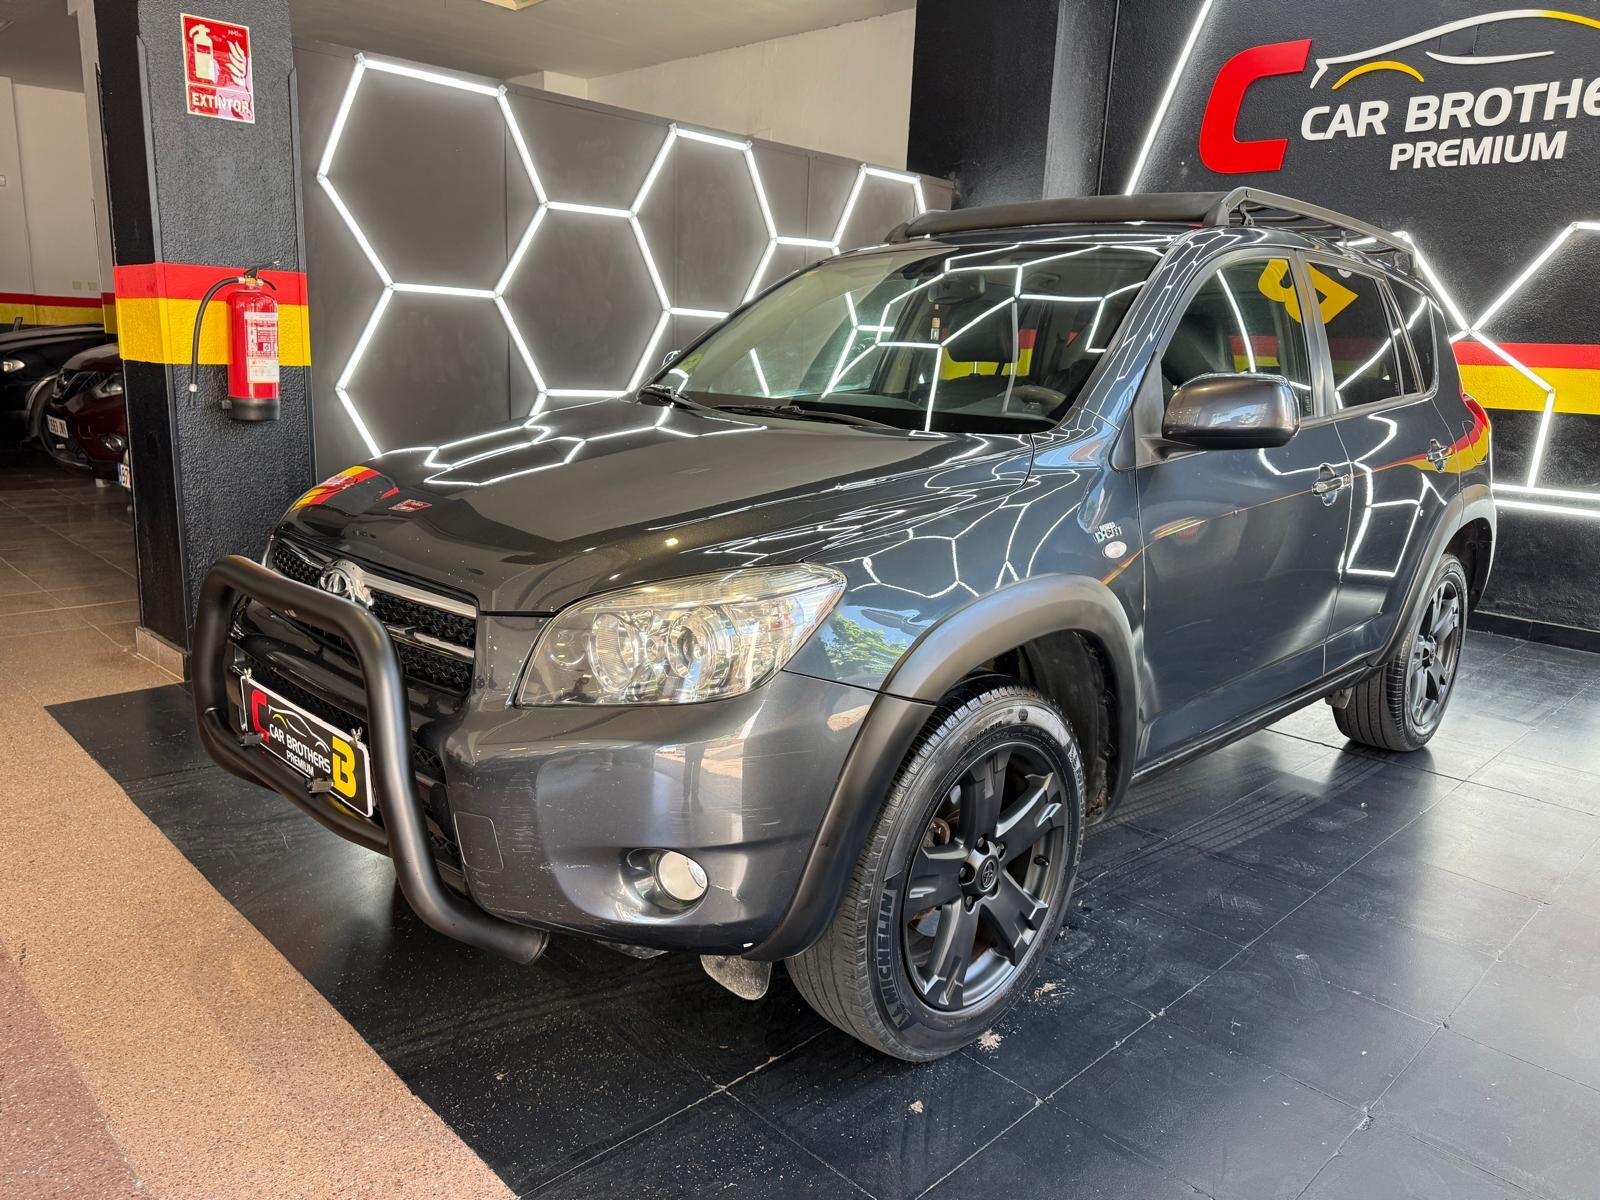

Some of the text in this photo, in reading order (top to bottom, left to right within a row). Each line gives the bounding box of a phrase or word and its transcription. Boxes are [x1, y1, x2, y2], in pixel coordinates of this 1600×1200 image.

[192, 92, 249, 113] EXTINTOR
[1301, 101, 1389, 141] CAR
[1389, 131, 1568, 170] PREMIUM
[269, 722, 331, 774] CAR BROTHERS
[286, 750, 315, 777] PREMIUM
[877, 892, 898, 1005] MICHELIN
